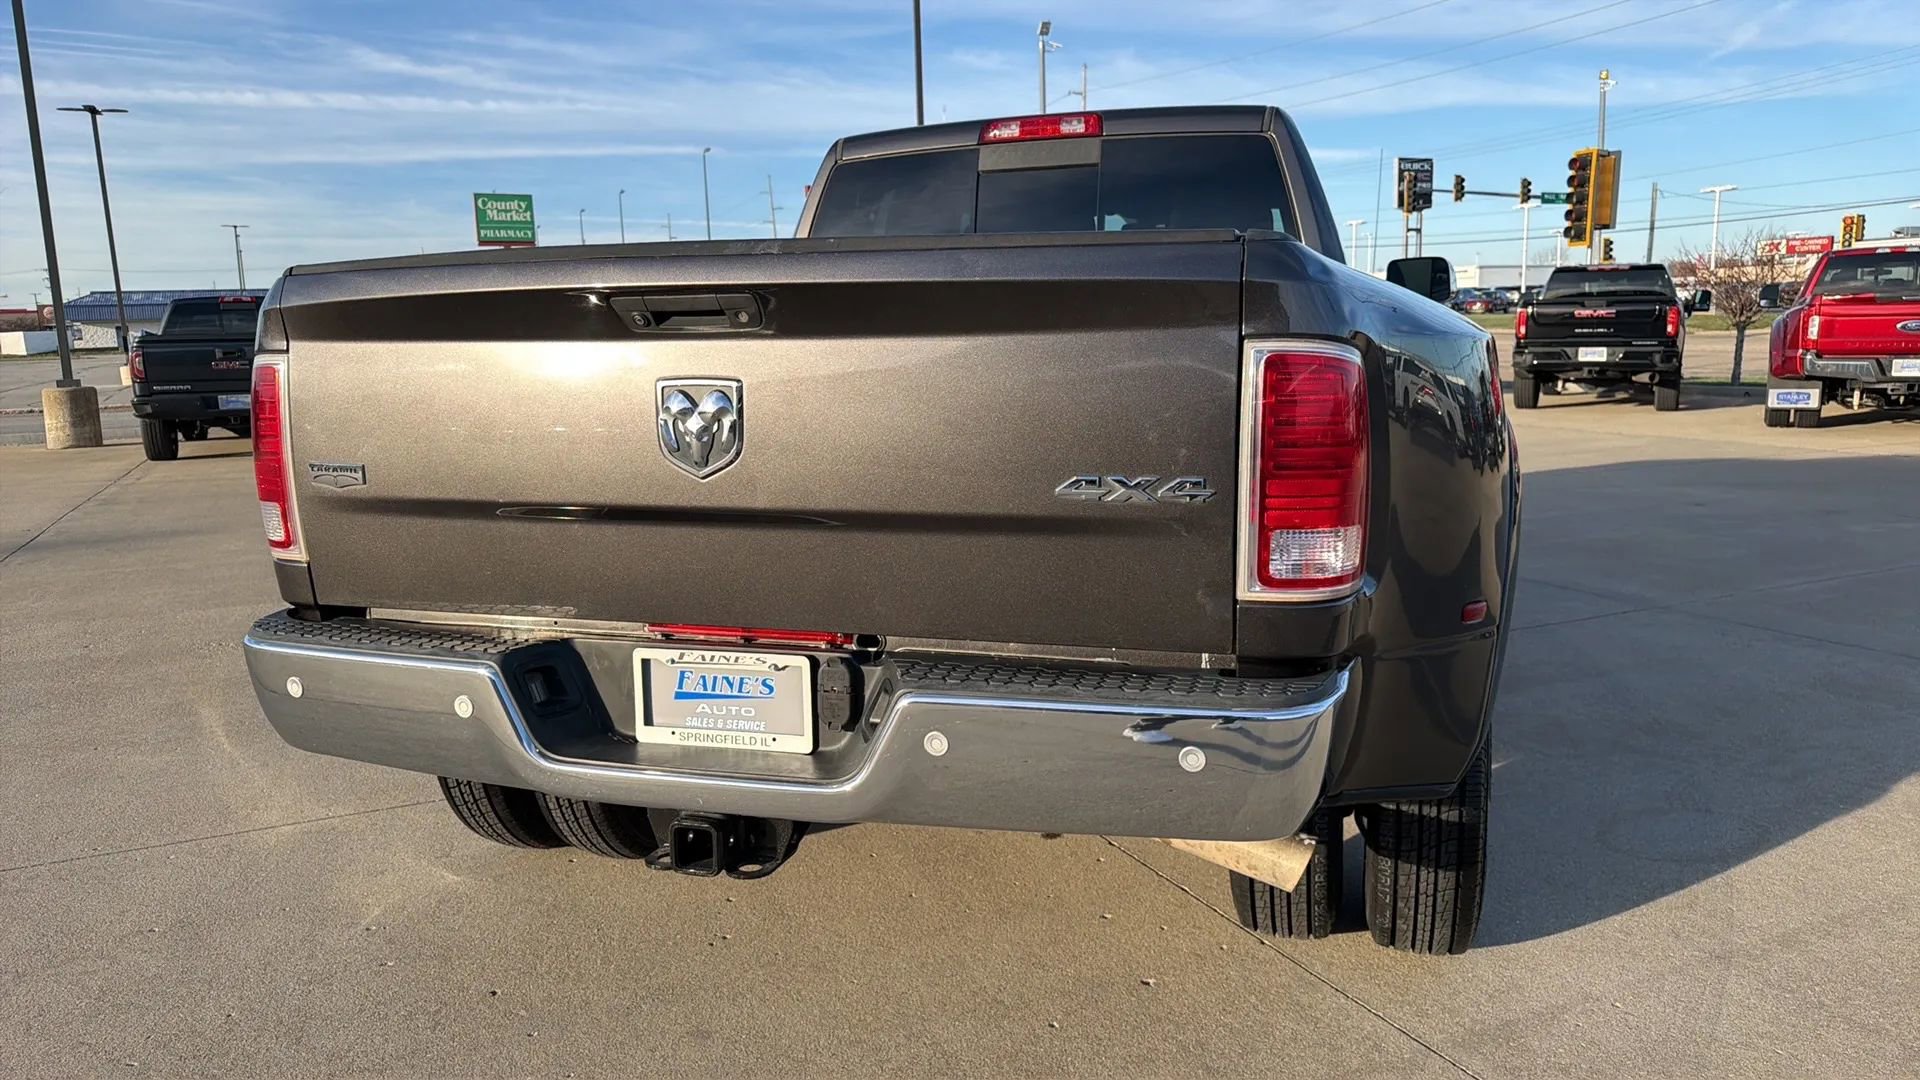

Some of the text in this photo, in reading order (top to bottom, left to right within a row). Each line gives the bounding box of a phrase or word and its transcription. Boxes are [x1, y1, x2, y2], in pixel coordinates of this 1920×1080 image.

[477, 197, 528, 212] County
[486, 209, 532, 221] Market
[480, 229, 533, 238] PHARMACY
[1574, 309, 1616, 318] GMC
[212, 361, 250, 369] GMC
[677, 651, 768, 665] FAINE'S
[676, 669, 776, 696] FAINE'S
[695, 703, 756, 717] AUTO
[685, 716, 767, 732] SALES & SERVICE
[679, 731, 771, 747] SPRINGFIELD IL
